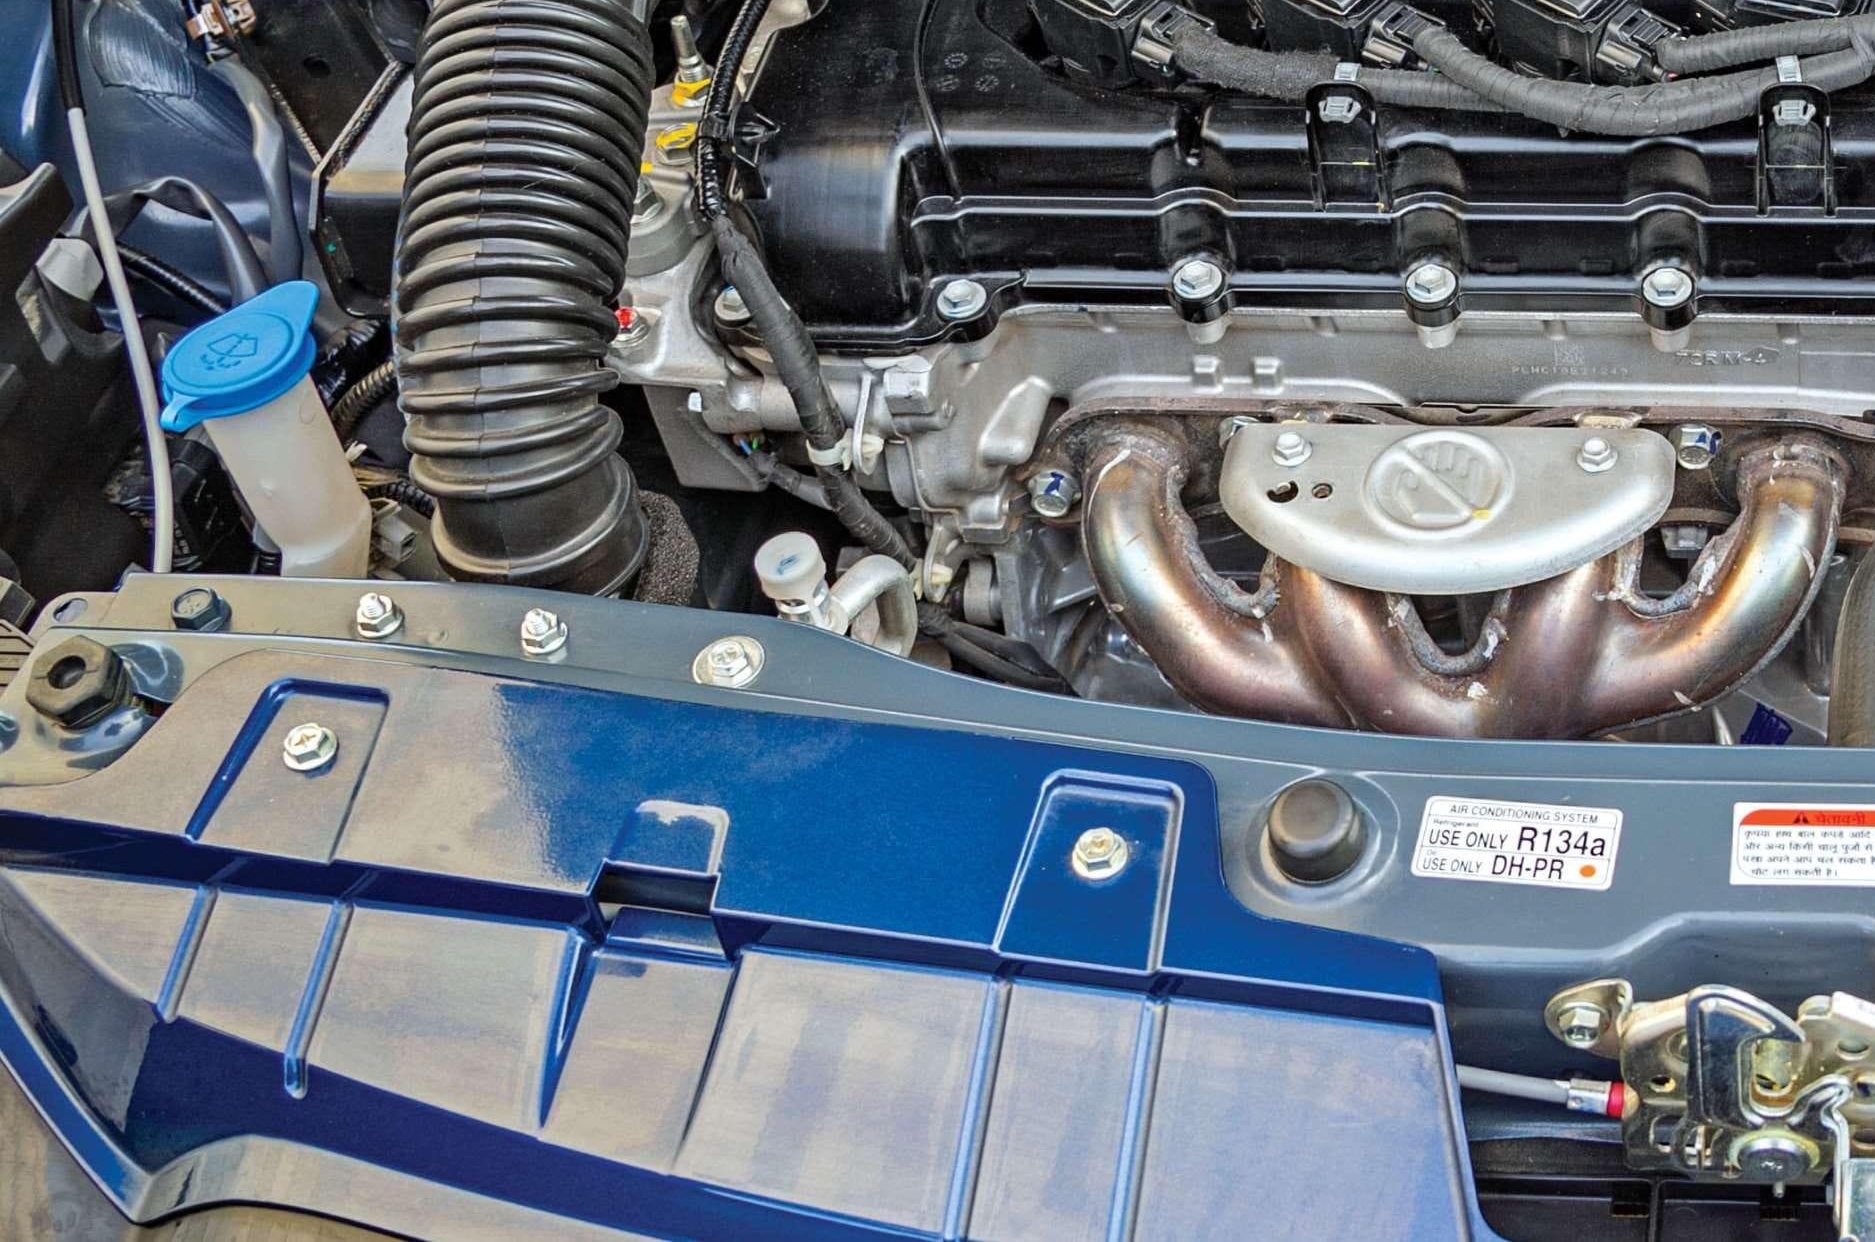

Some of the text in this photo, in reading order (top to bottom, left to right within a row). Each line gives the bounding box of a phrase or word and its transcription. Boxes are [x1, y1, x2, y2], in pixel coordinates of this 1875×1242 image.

[1450, 804, 1598, 824] AIR CONDITIONING SYSTEM
[1429, 826, 1606, 856] USE ONLY R134a
[1423, 855, 1564, 880] USE ONLY DH-PR
